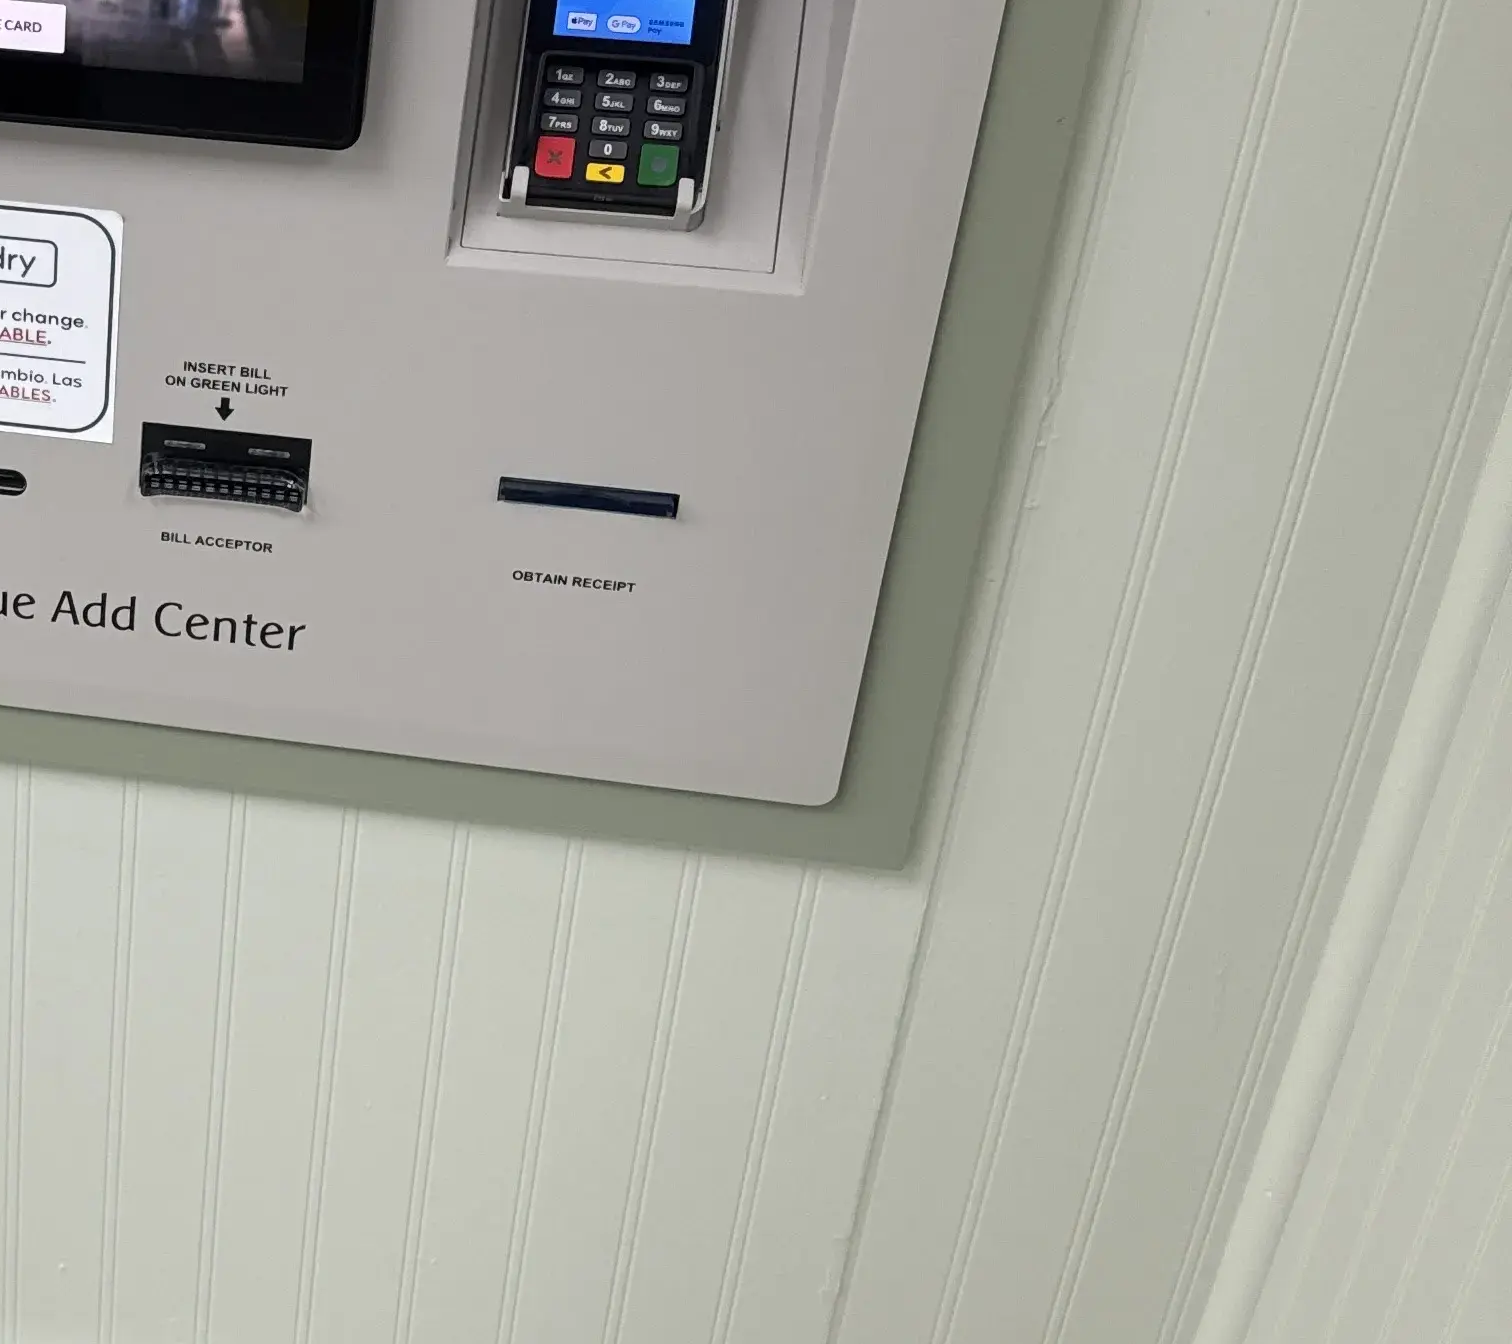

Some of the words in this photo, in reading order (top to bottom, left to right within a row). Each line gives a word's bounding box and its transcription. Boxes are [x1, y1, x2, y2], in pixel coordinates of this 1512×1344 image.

[4, 17, 43, 34] CARD
[577, 15, 594, 28] Pay
[603, 143, 613, 156] 0
[11, 308, 88, 331] change.
[52, 372, 83, 388] Las
[183, 360, 236, 379] INSERT
[240, 365, 272, 381] BILL
[164, 373, 188, 389] ON
[191, 376, 242, 394] GREEN
[245, 381, 289, 398] LIGHT
[160, 531, 192, 545] BILL
[194, 534, 274, 554] ACCEPTOR
[512, 569, 569, 587] OBTAIN
[571, 576, 637, 594] RECEIPT
[50, 589, 137, 632] Add
[154, 601, 307, 652] Center
